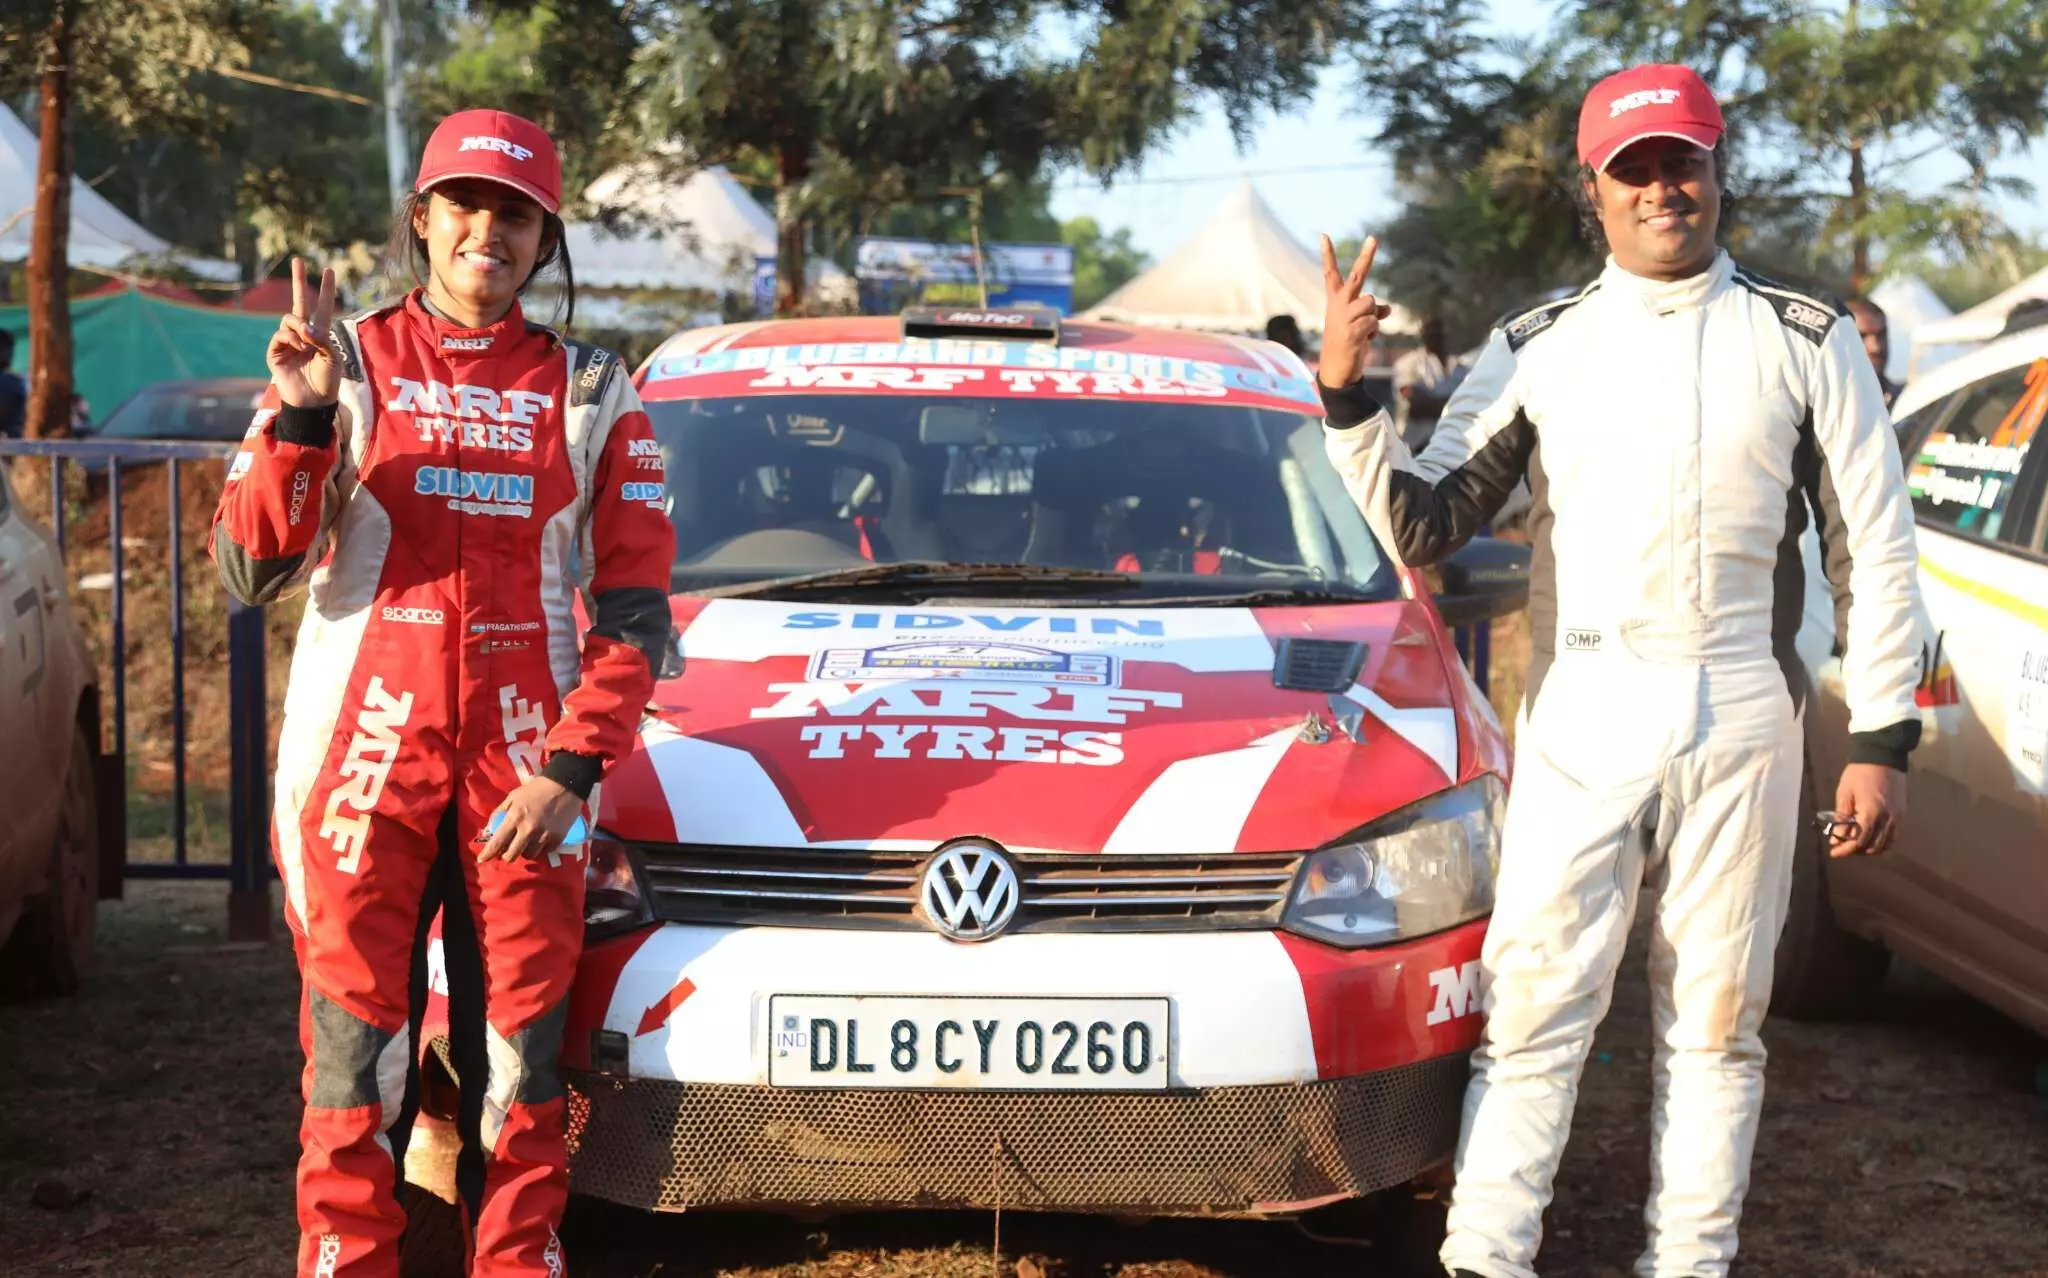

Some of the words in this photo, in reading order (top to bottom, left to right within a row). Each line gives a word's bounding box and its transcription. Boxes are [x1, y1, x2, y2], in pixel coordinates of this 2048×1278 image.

[1609, 87, 1680, 118] MRF
[458, 136, 534, 161] MRF
[1785, 301, 1828, 328] OMP
[441, 336, 495, 350] MRF
[579, 347, 611, 389] sparco
[736, 338, 1006, 369] BLUEBAND
[1023, 341, 1226, 386] SPORTS
[748, 365, 985, 391] MRF
[1001, 369, 1228, 398] TYRES
[388, 376, 554, 425] MRF
[415, 416, 533, 451] TYRES
[289, 471, 310, 526] sparco
[414, 464, 534, 504] SIDVIN
[382, 606, 444, 624] sparco
[781, 612, 1165, 637] SIDVIN
[1565, 632, 1602, 648] OMP
[750, 681, 1183, 725] MRF
[800, 724, 1125, 766] TYRES
[319, 675, 415, 875] MRF
[777, 1033, 807, 1048] IND
[809, 1018, 876, 1074] DL
[889, 1019, 919, 1074] 8
[934, 1019, 1000, 1074] CY
[1014, 1019, 1151, 1075] 0260
